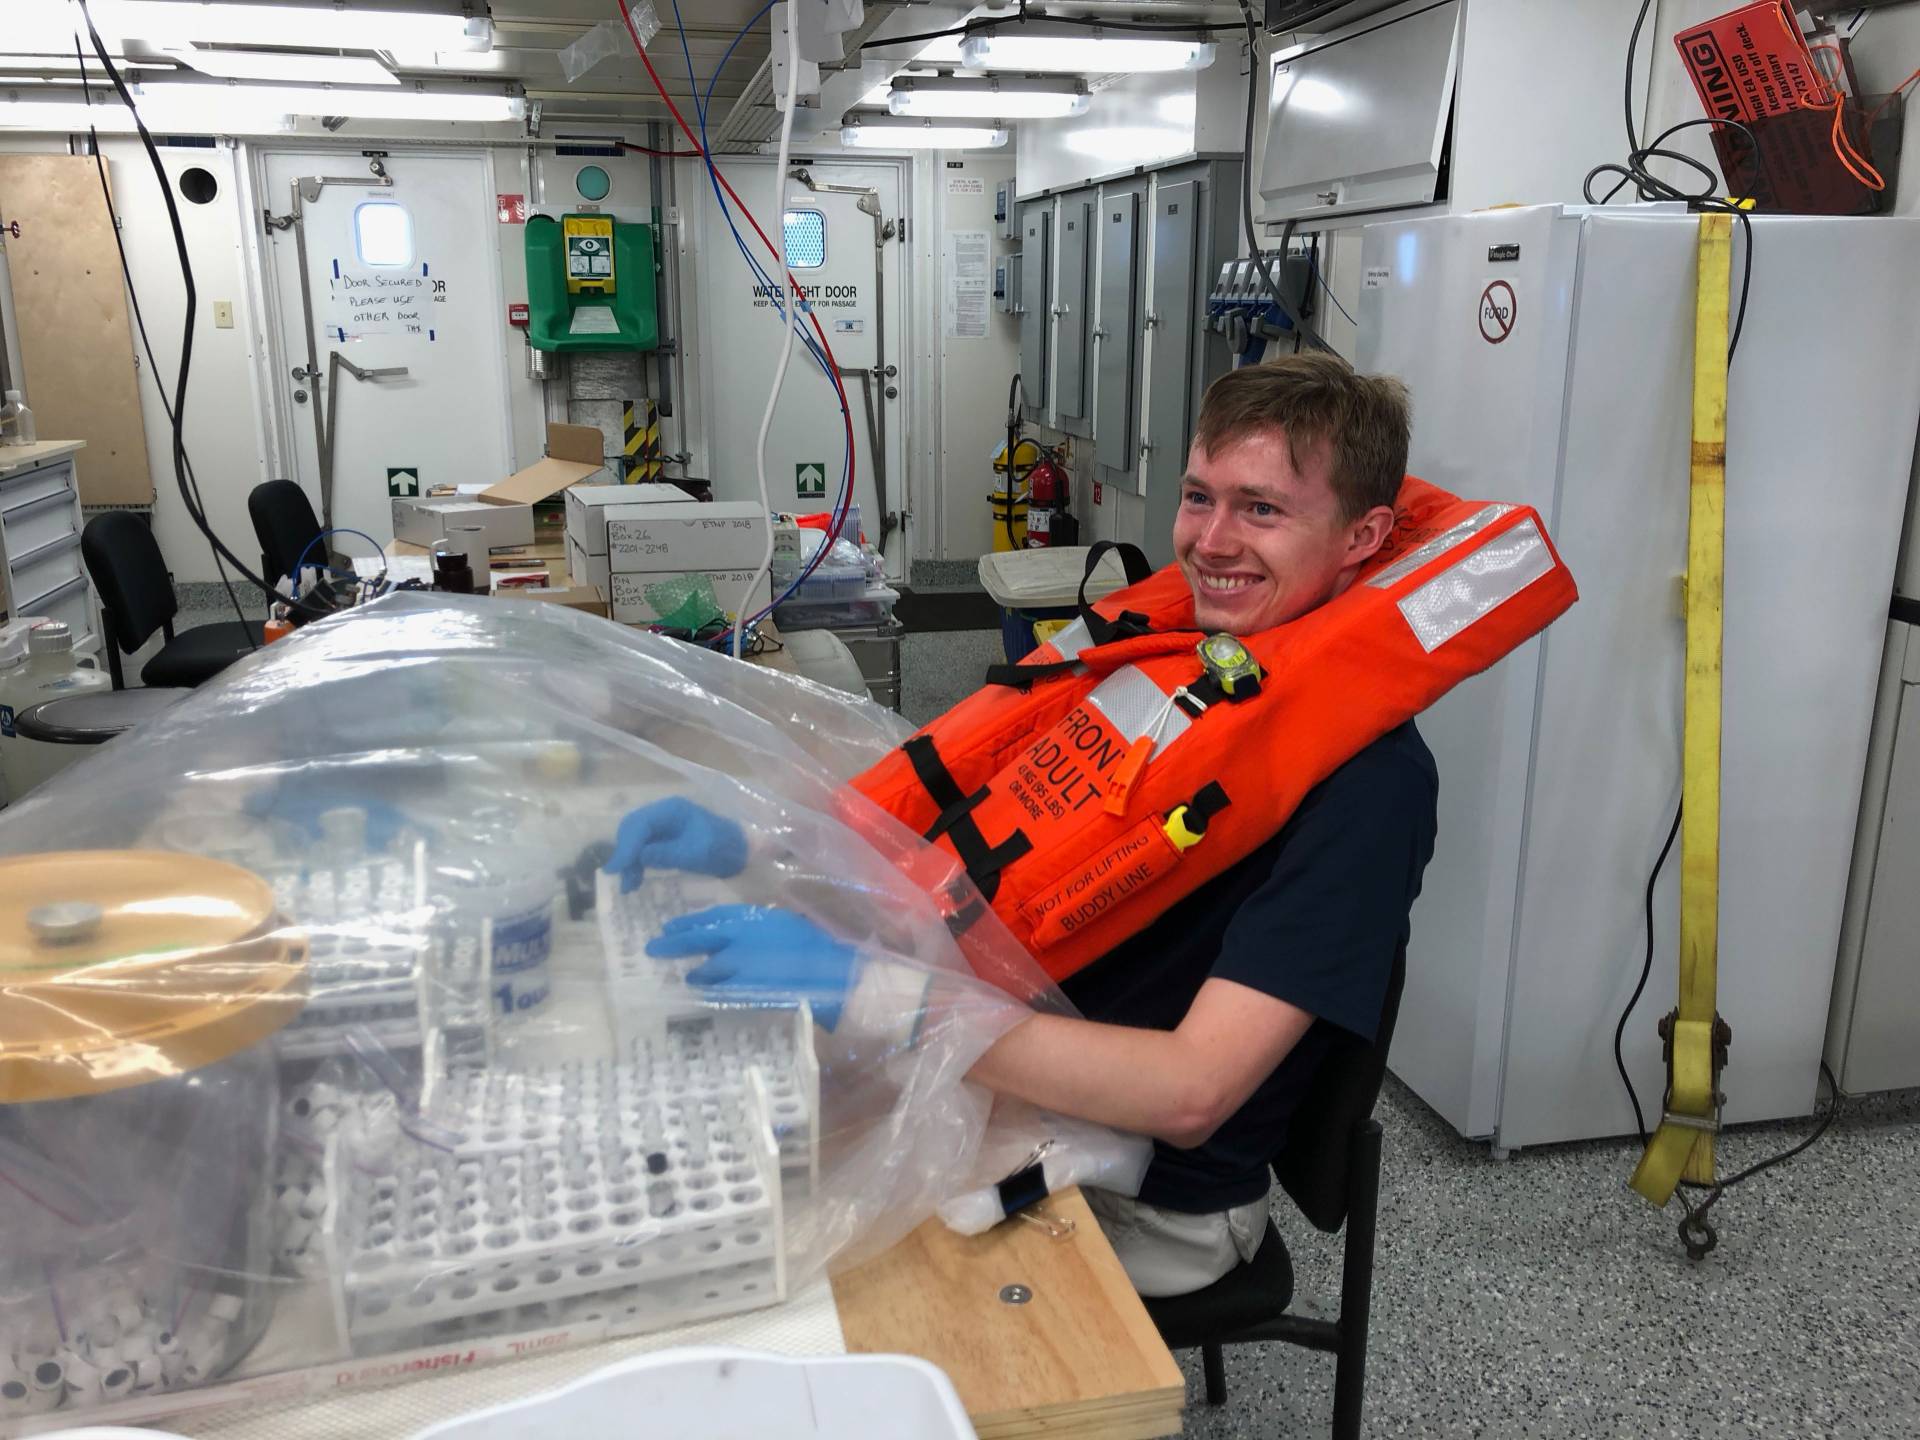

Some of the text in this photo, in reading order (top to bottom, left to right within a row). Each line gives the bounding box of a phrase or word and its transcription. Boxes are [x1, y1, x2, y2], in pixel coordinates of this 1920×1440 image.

[1766, 53, 1793, 101] Auxiliary
[1762, 86, 1781, 112] Keep
[375, 275, 422, 287] SECURED
[825, 286, 857, 298] DOOR
[349, 296, 415, 307] PLEASE USE
[753, 300, 769, 308] KEEP
[818, 300, 830, 308] FOR
[831, 300, 857, 308] PASSAGE
[353, 312, 420, 322] OTHER DOOR
[1484, 306, 1508, 320] FOOD
[732, 521, 752, 529] 2018
[611, 532, 632, 541] Box
[731, 574, 754, 582] 2018
[614, 584, 640, 595] Box
[1027, 737, 1102, 811] ADULT
[1016, 790, 1044, 821] MORE
[1034, 834, 1150, 919] NOT FOR LIFTING
[1060, 862, 1155, 932] BUDDY LINE
